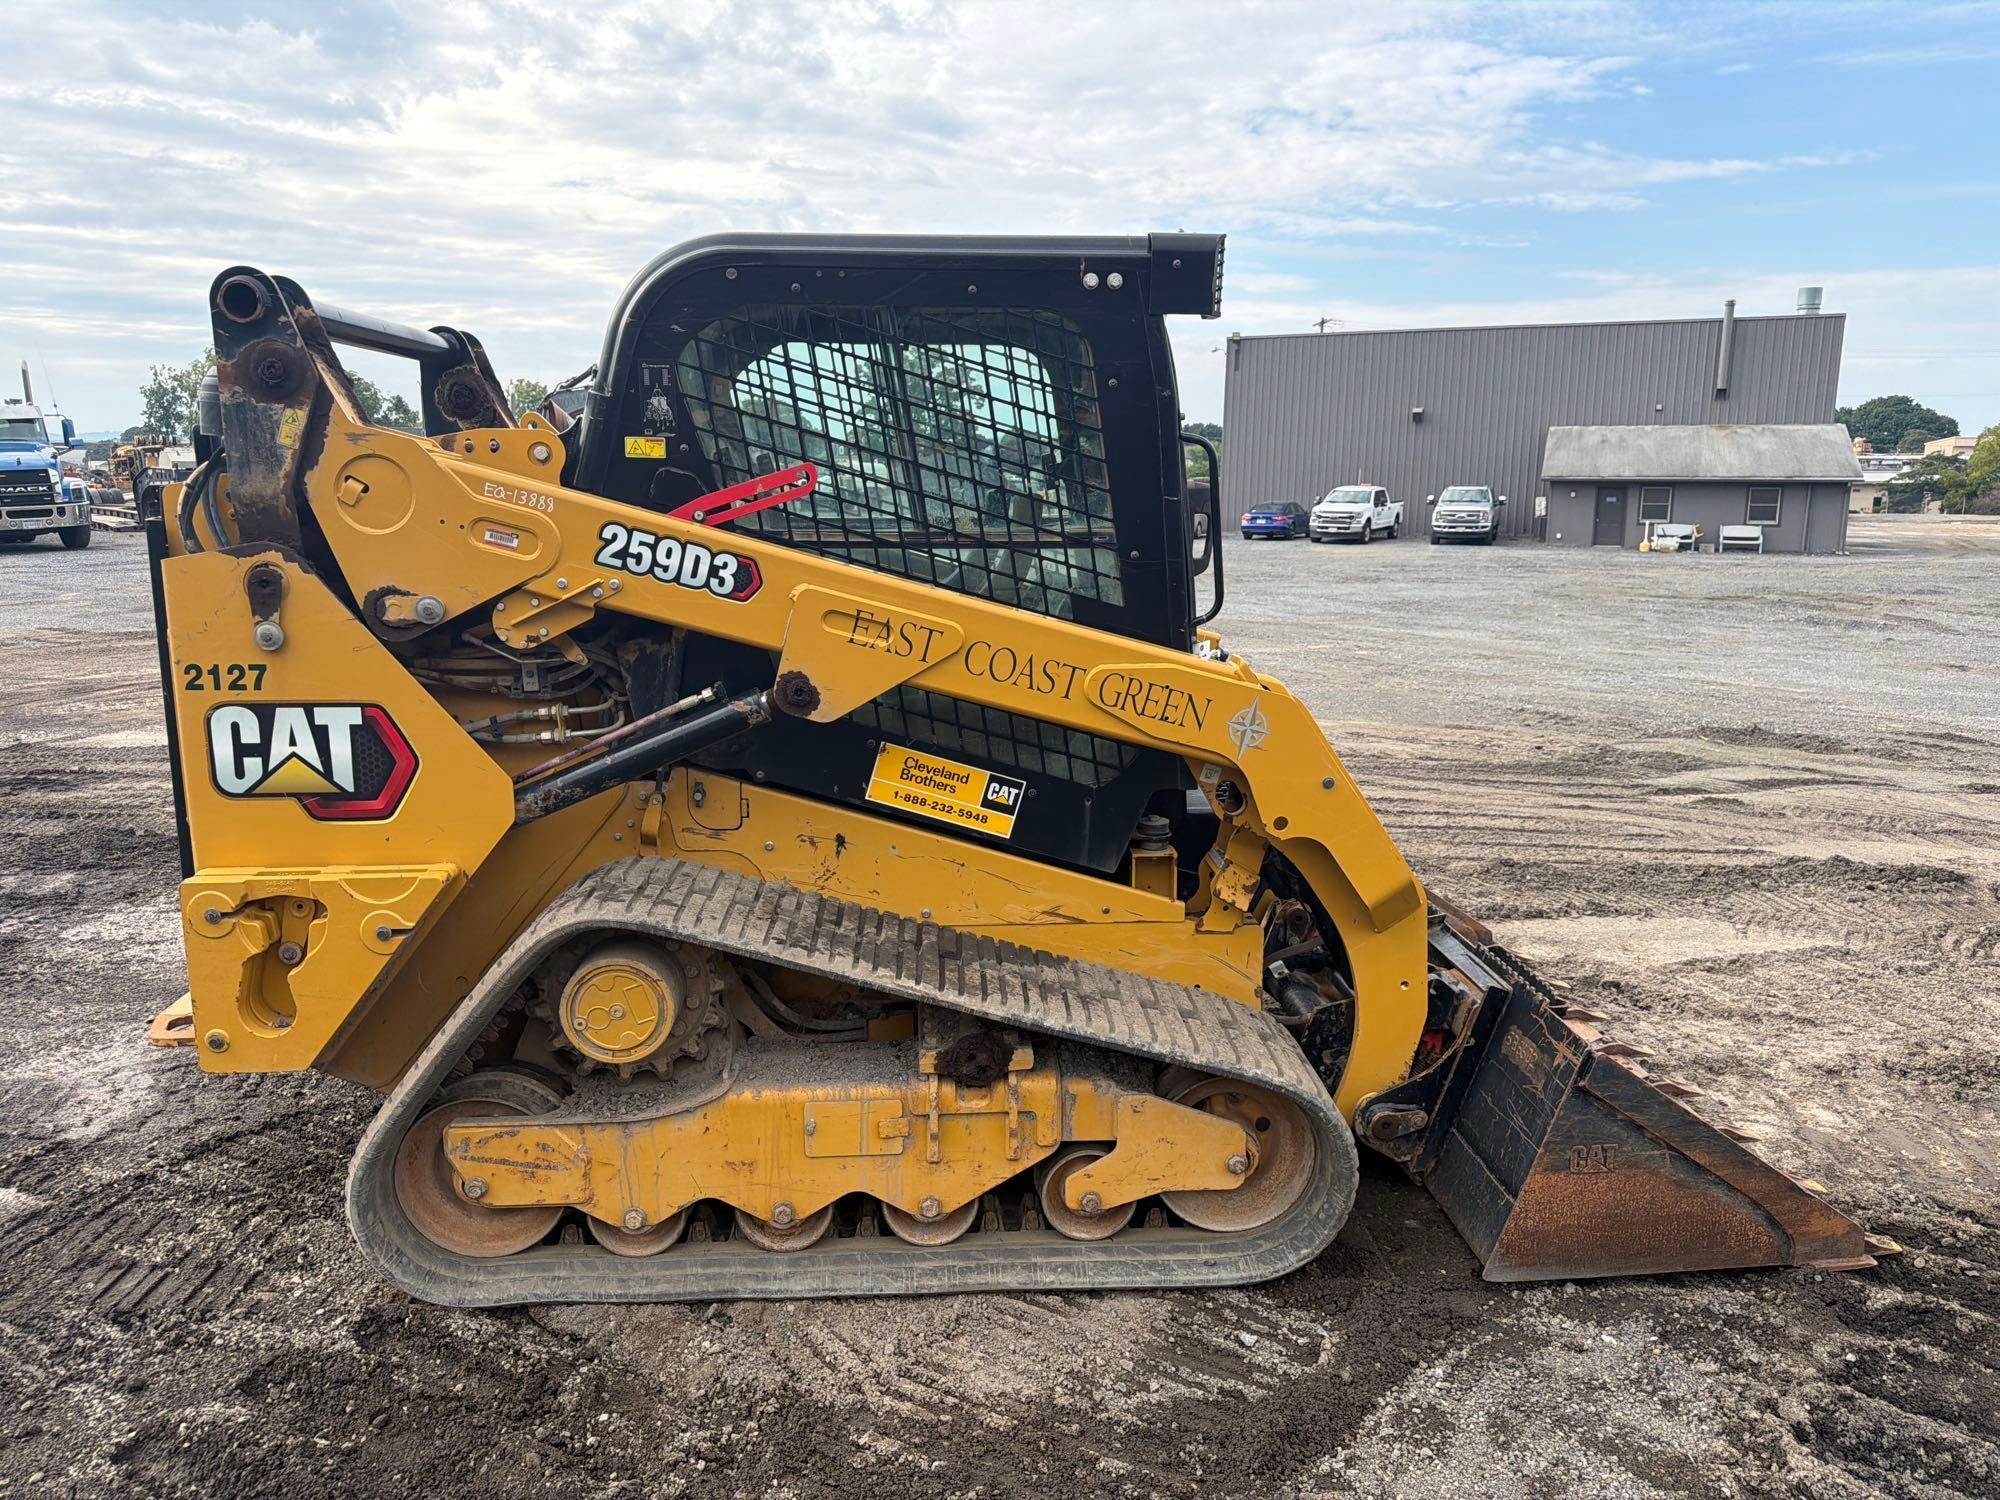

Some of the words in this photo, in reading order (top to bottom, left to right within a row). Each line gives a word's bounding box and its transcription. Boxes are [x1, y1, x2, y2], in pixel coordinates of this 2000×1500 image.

[484, 482, 554, 512] EQ-13888
[597, 524, 738, 595] 259D3
[184, 664, 267, 691] 2127
[847, 609, 944, 663] EAST
[964, 640, 1087, 700] COAST
[1099, 673, 1212, 732] GREEN
[210, 706, 362, 793] CAT
[900, 768, 957, 794] Brothers
[904, 756, 970, 785] Cleveland
[893, 790, 989, 824] 1-888-232-5948
[987, 782, 1018, 806] CAT
[1569, 1143, 1618, 1173] CAT
